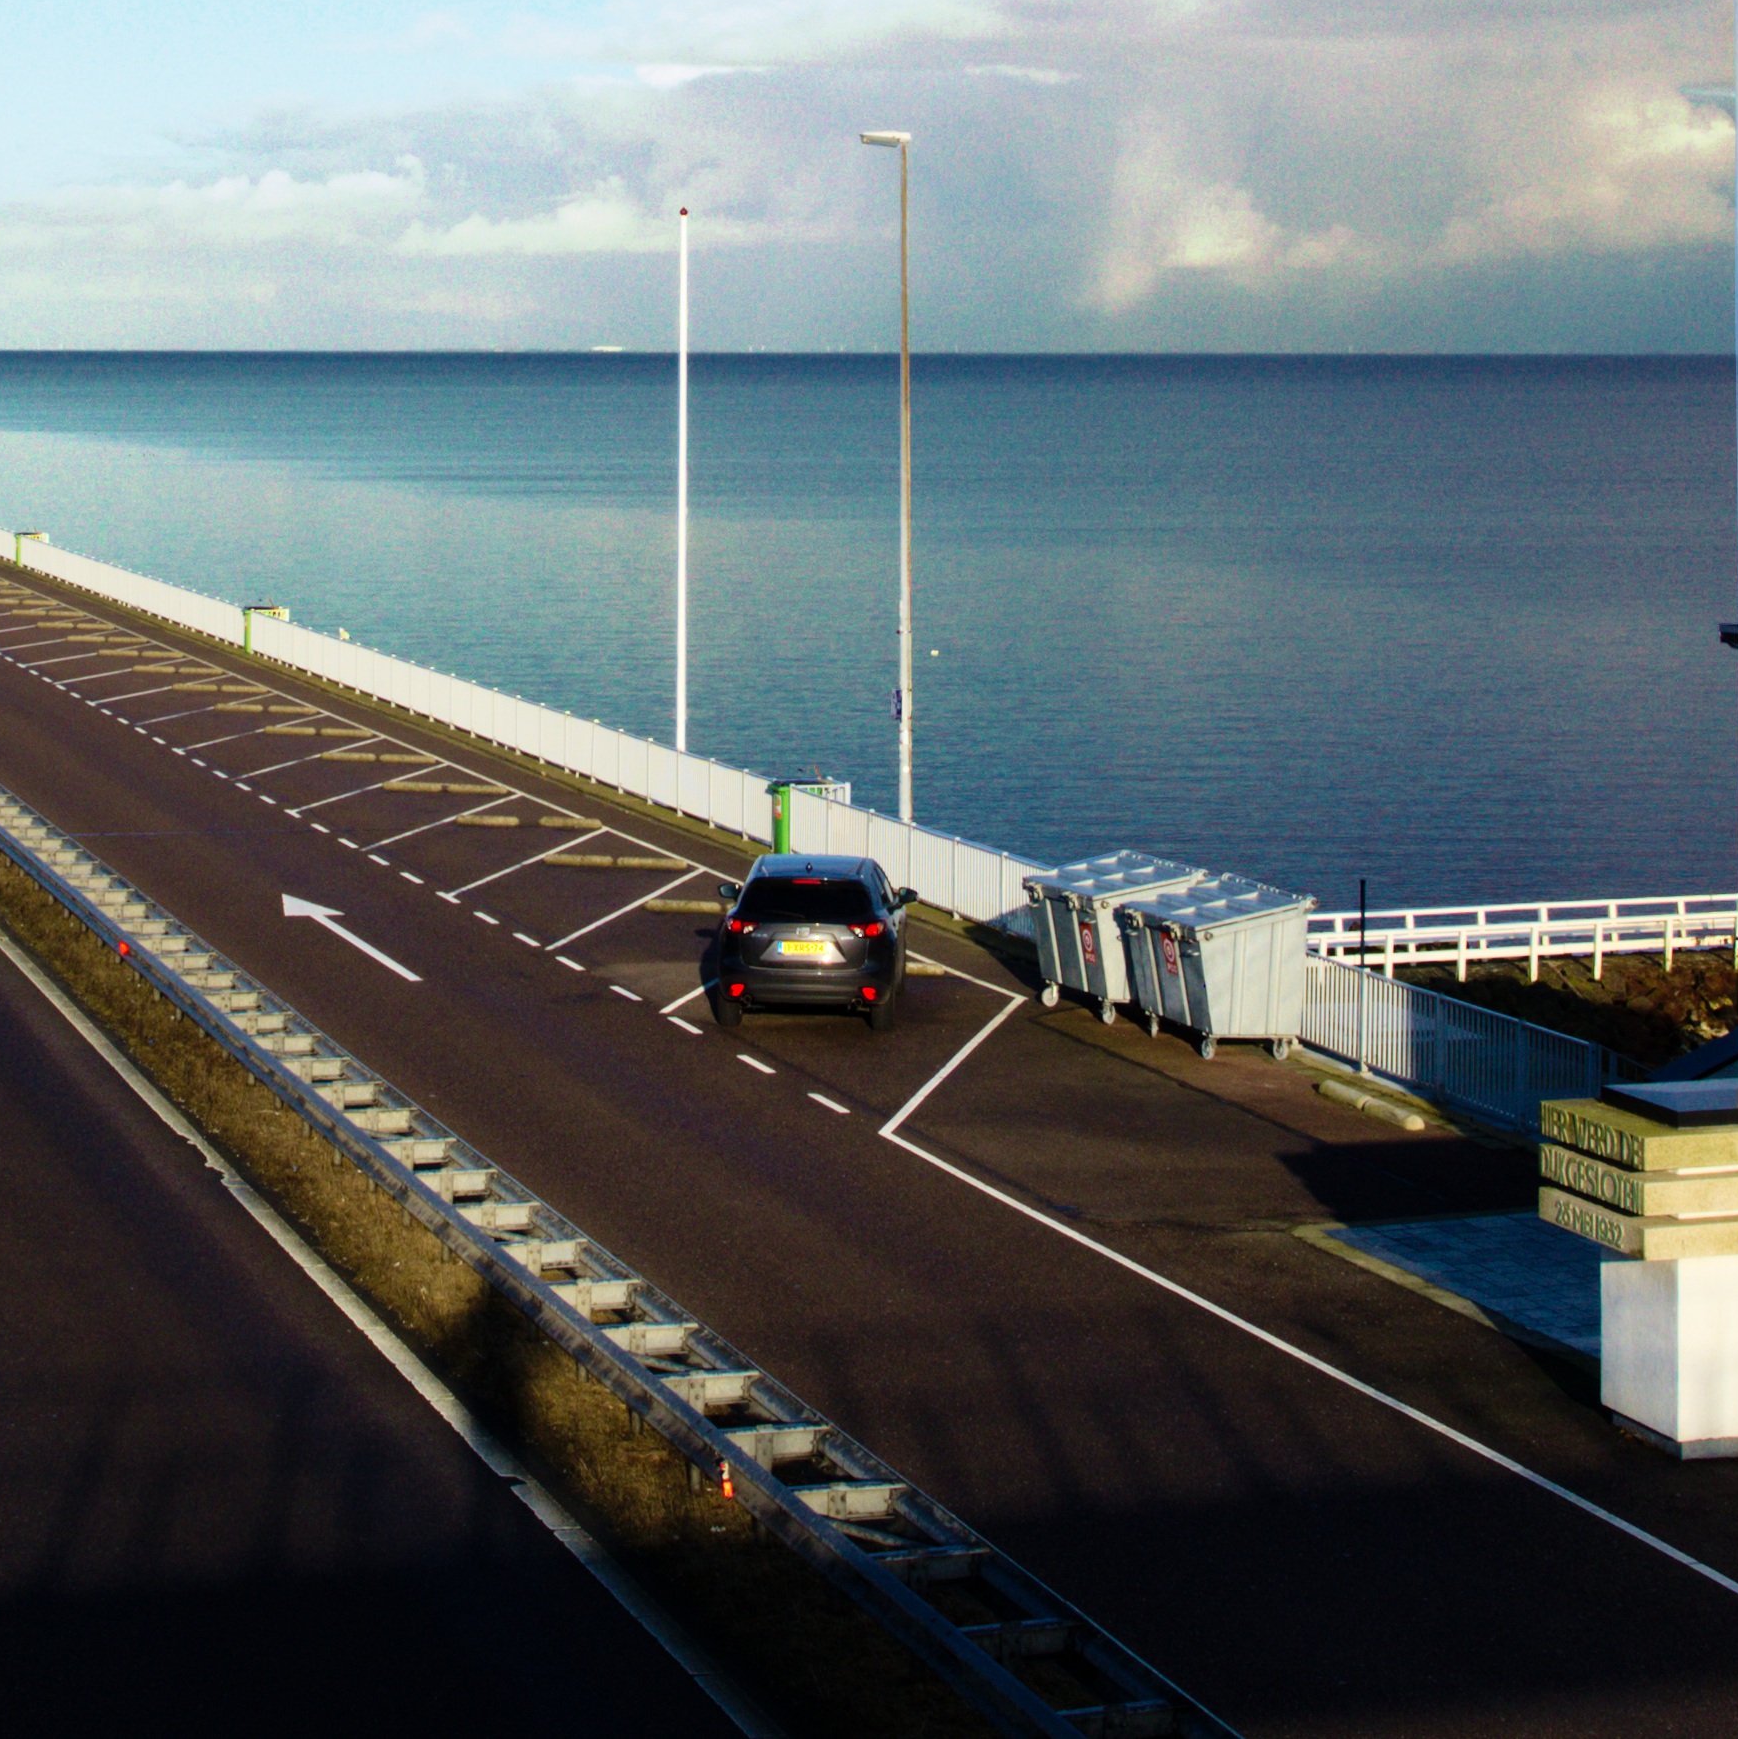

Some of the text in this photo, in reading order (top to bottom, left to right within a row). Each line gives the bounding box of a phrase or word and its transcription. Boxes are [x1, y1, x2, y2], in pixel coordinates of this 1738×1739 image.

[1541, 1103, 1643, 1171] HIER WERD DE
[1573, 1206, 1596, 1239] MEI
[1597, 1214, 1624, 1250] 1932
